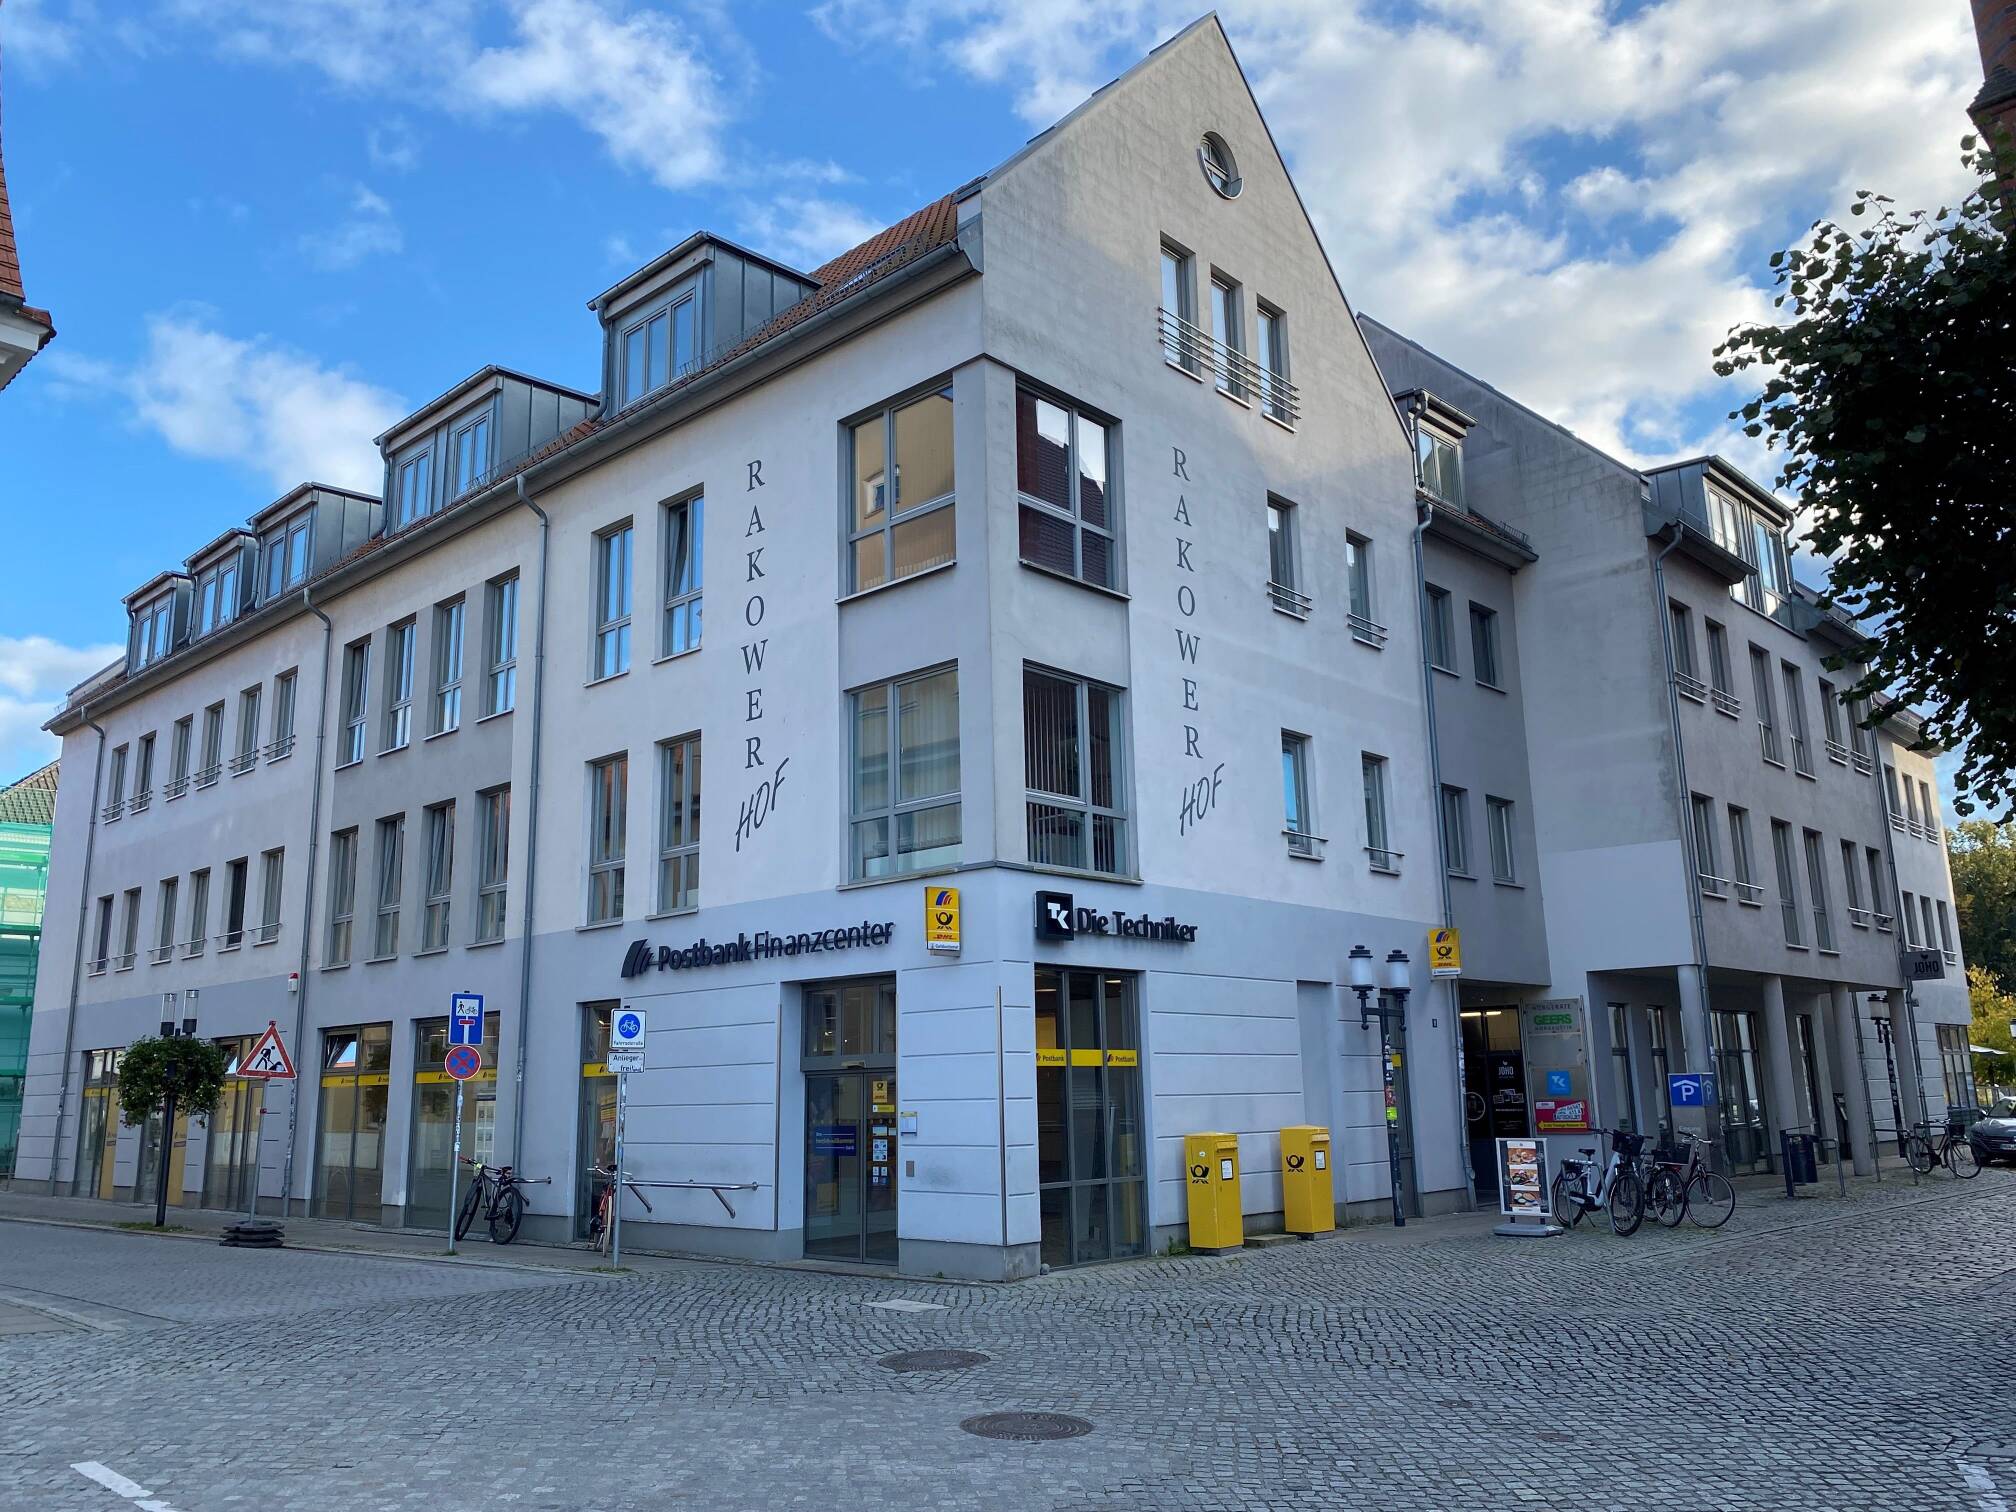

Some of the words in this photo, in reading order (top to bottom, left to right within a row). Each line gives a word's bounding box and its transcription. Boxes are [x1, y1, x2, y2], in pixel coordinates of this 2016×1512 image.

[740, 459, 769, 769] RAKOWER
[1172, 446, 1203, 760] RAKOWER
[735, 757, 789, 852] HOF
[1179, 763, 1224, 836] HOF
[1047, 902, 1069, 930] TK
[1074, 907, 1109, 935] Die
[1112, 910, 1198, 942] Techniker
[658, 938, 752, 971] Postbank
[753, 920, 894, 960] Finanzcenter
[1913, 961, 1940, 973] JOHO
[1534, 1013, 1572, 1026] GEERS
[613, 1054, 640, 1062] Anlieger
[1042, 1053, 1064, 1062] Postbank
[1551, 1075, 1566, 1087] TK
[1681, 1084, 1695, 1102] P
